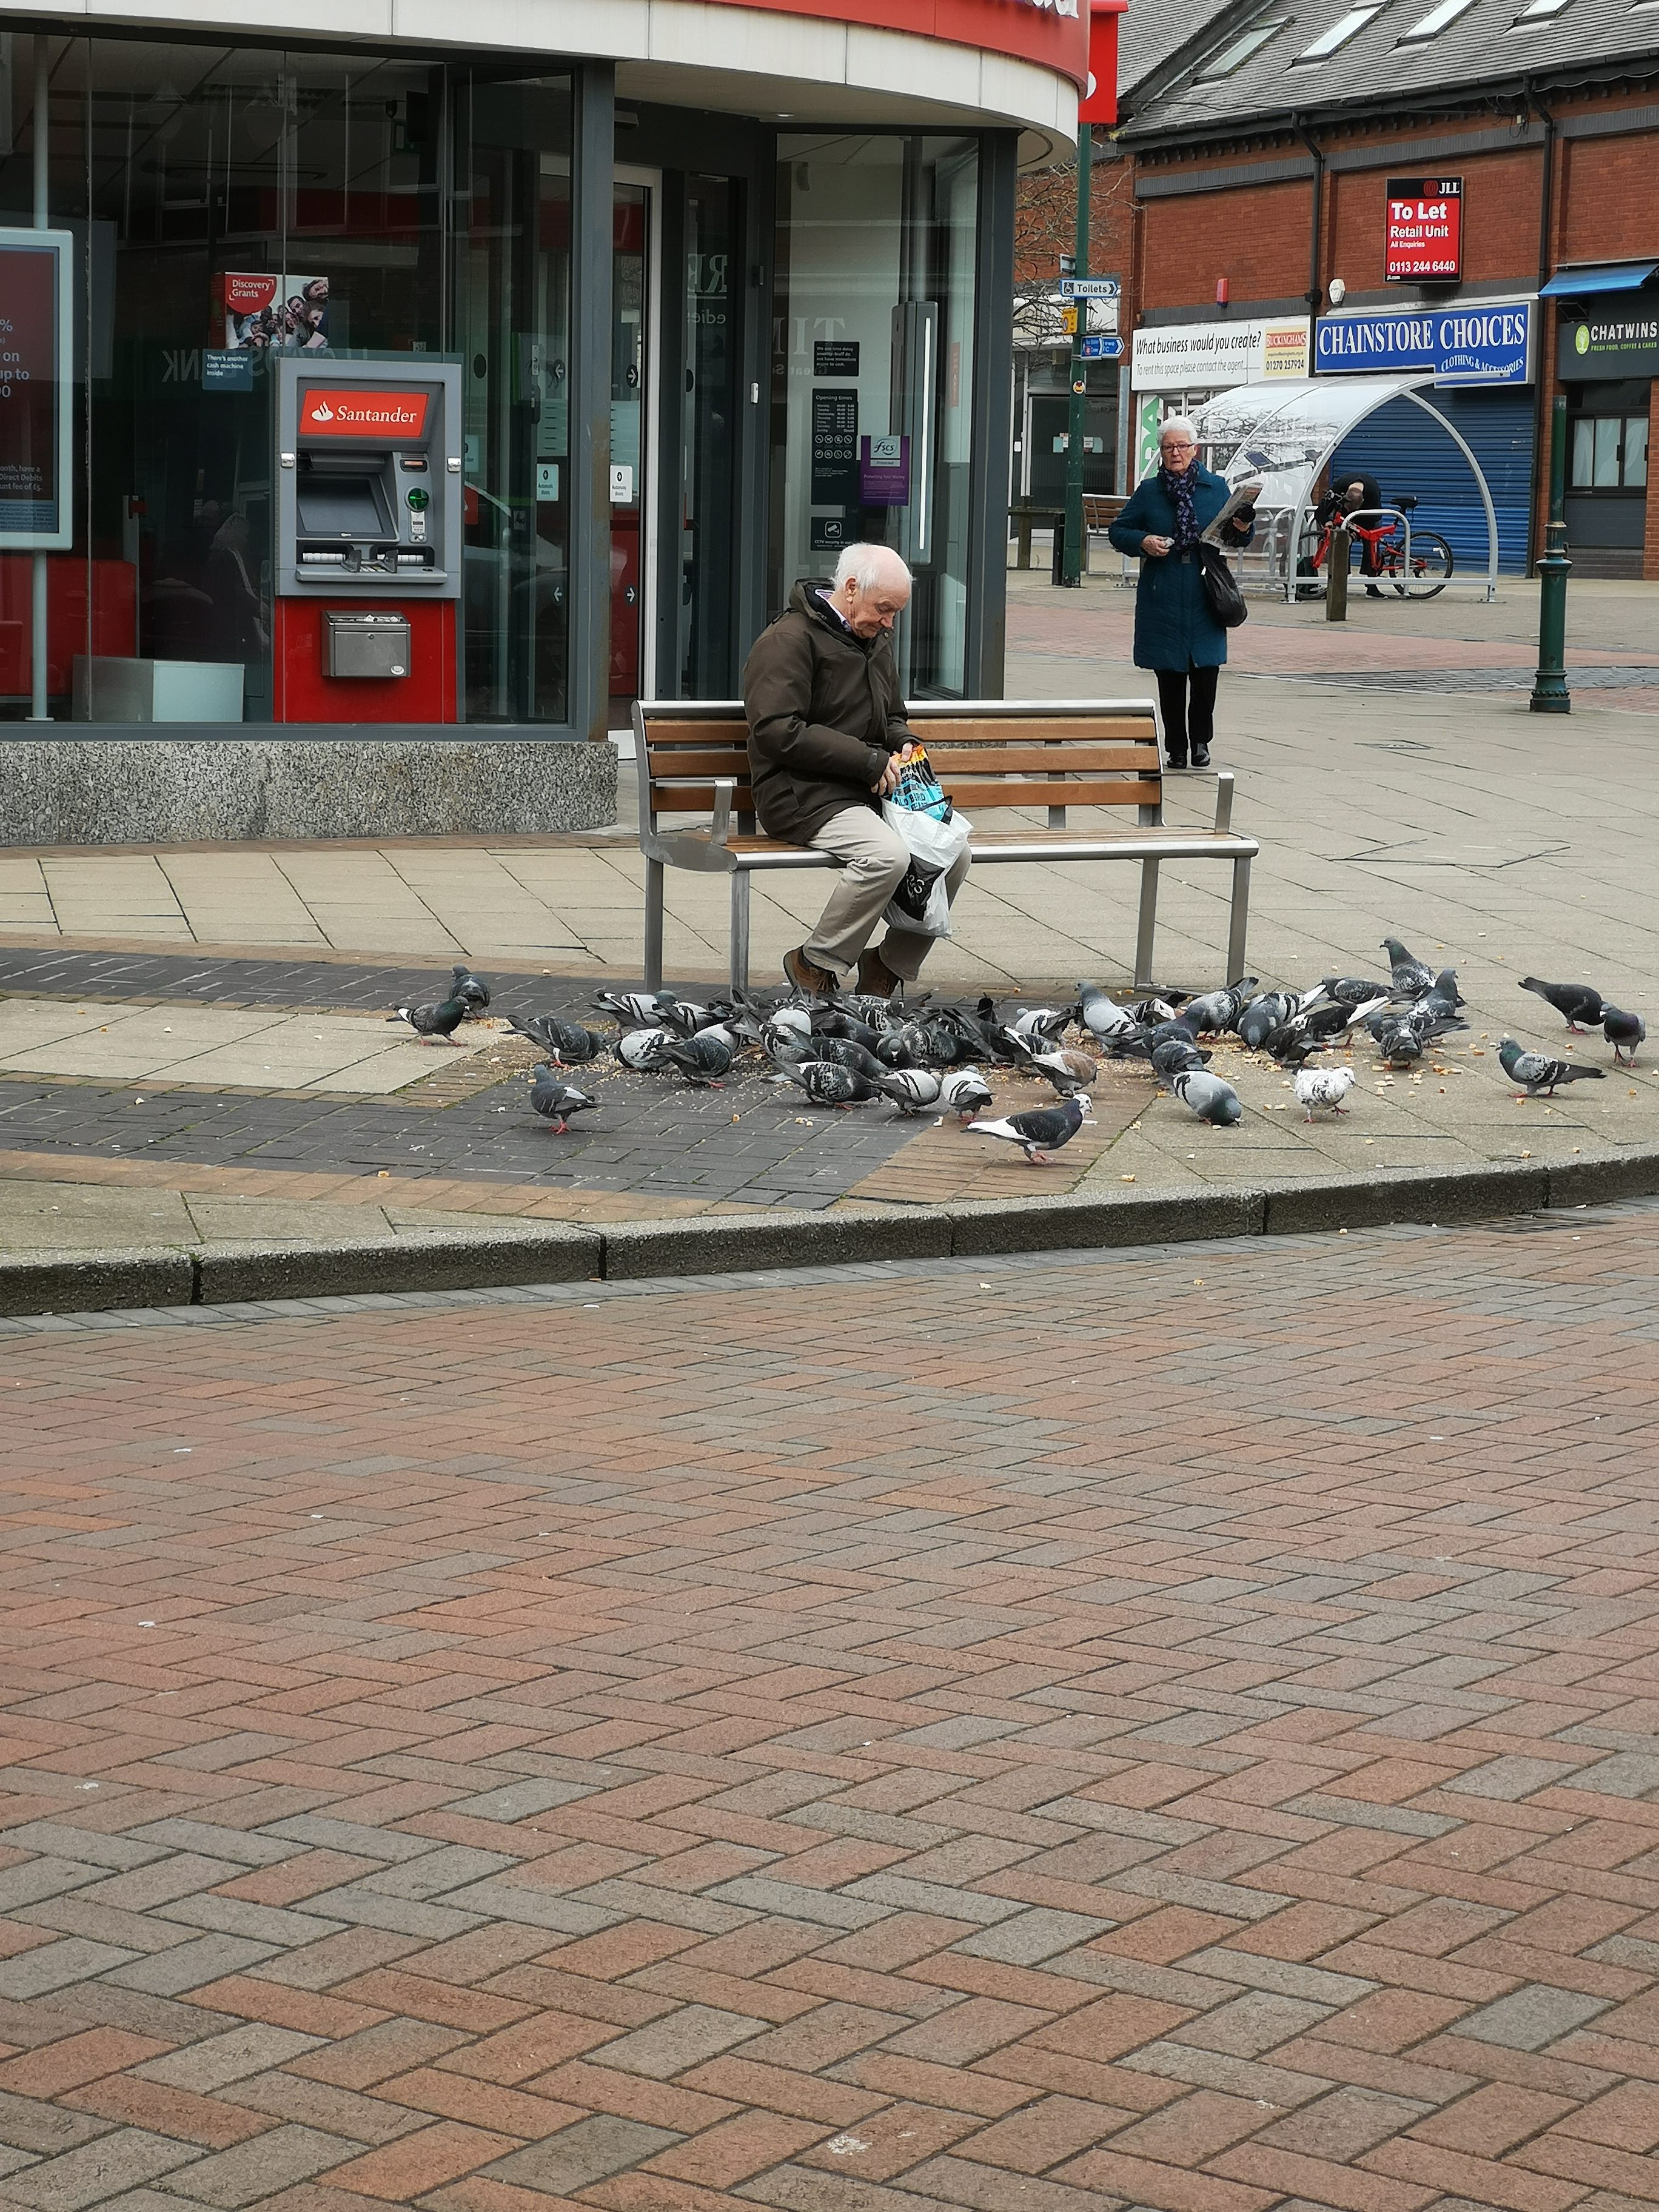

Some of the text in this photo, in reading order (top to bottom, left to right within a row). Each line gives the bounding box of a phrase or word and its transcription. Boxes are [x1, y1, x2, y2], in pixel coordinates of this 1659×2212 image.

[1439, 183, 1460, 193] JLL
[1391, 202, 1447, 220] To Let
[1390, 225, 1449, 238] Retail Unit
[1390, 260, 1455, 272] 0113 244 6440
[232, 279, 270, 290] Discovery
[1078, 284, 1107, 293] Toilets
[232, 289, 258, 297] Grants
[1319, 313, 1526, 355] CHAINSTORE CHOICES
[1591, 321, 1658, 341] CHATWINS
[1136, 331, 1261, 355] What business would you create?
[1266, 333, 1306, 346] BUCKINGHAMS
[3, 352, 19, 361] on
[1137, 364, 1143, 375] To
[1144, 364, 1153, 375] rent
[1155, 363, 1164, 375] this
[1164, 364, 1179, 377] space
[1179, 361, 1196, 376] please
[1196, 361, 1217, 372] contact
[1218, 359, 1226, 371] the
[1266, 360, 1304, 370] 01270 257924
[1441, 354, 1474, 372] CLOTHING
[1475, 358, 1480, 370] &
[16, 368, 29, 380] to
[337, 405, 417, 423] Santander
[909, 792, 925, 804] BIRD
